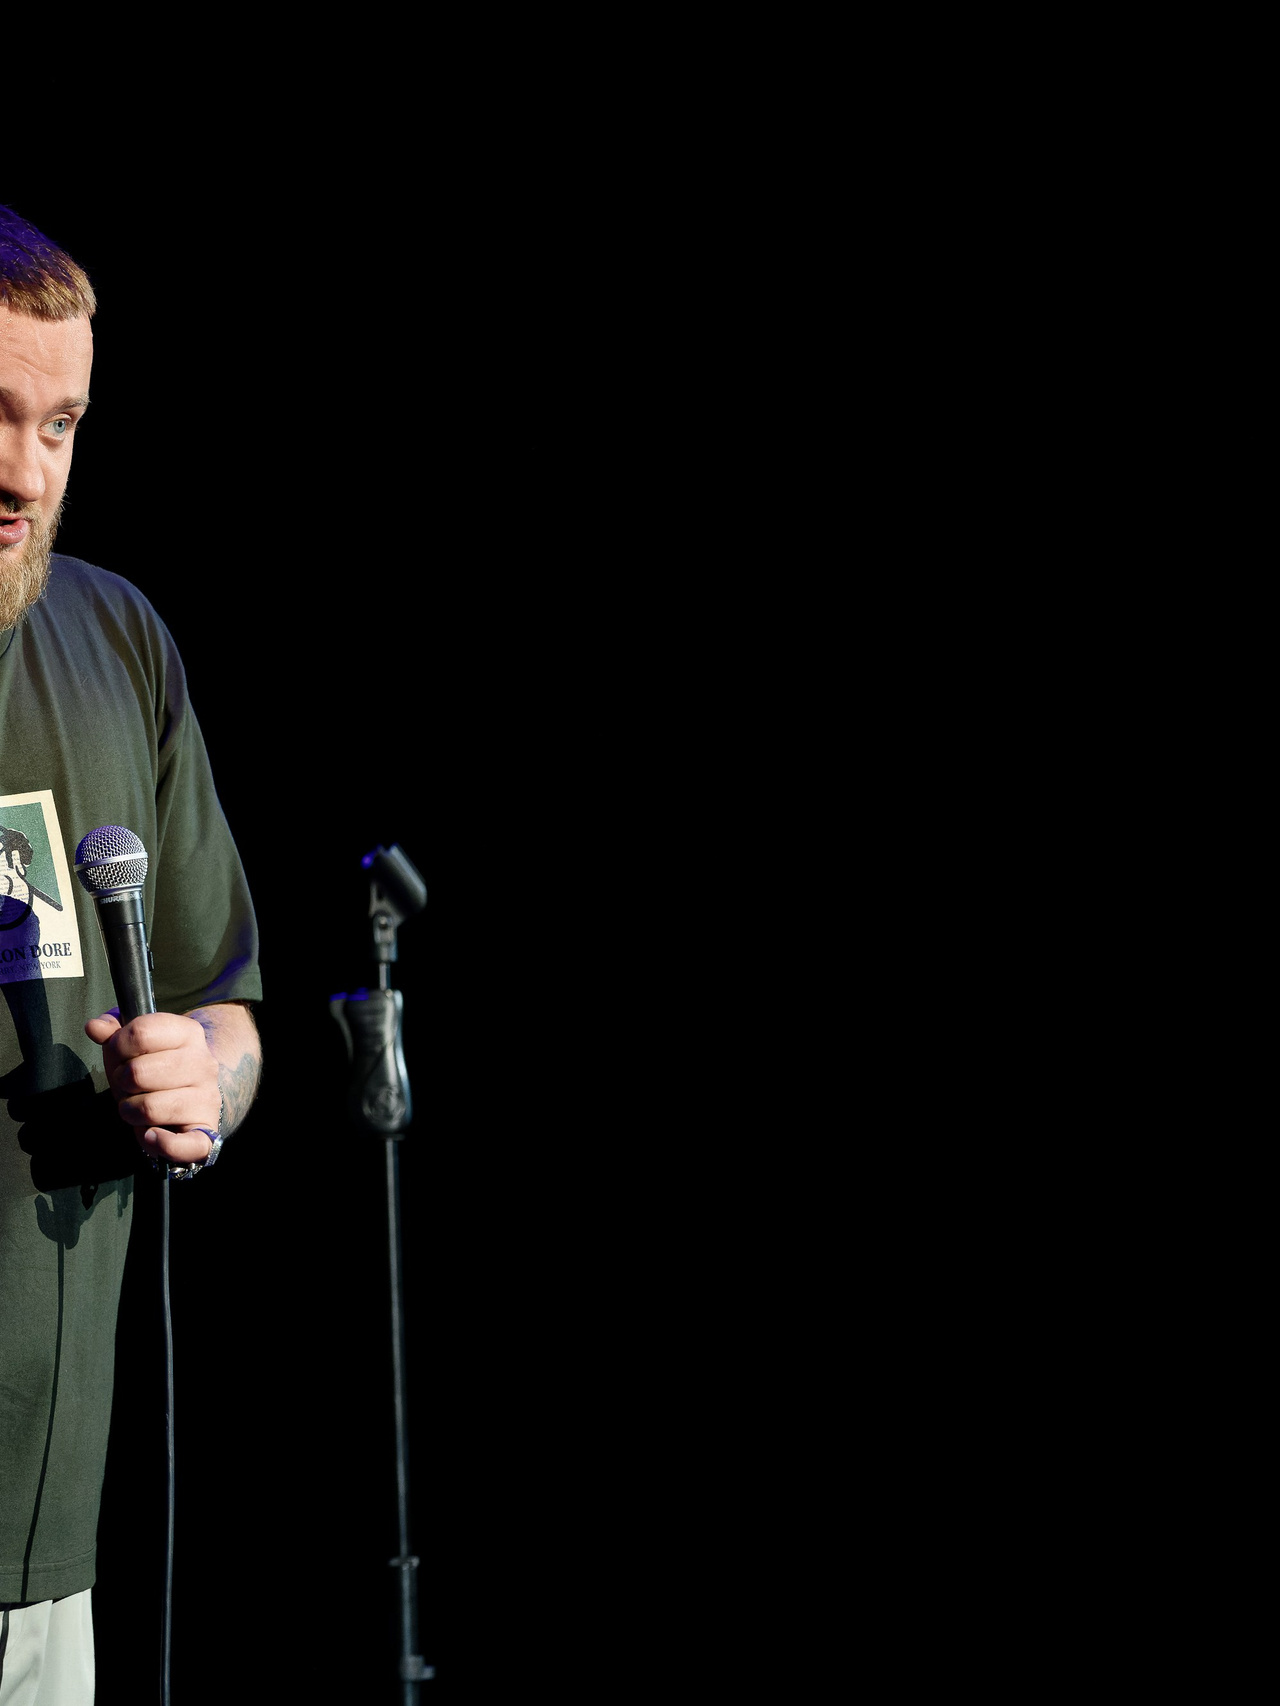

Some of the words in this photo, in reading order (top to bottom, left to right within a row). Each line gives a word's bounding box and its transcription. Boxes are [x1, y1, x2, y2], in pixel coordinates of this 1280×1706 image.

[30, 943, 72, 958] DORE
[18, 963, 38, 972] NEW
[41, 961, 61, 970] YORK
